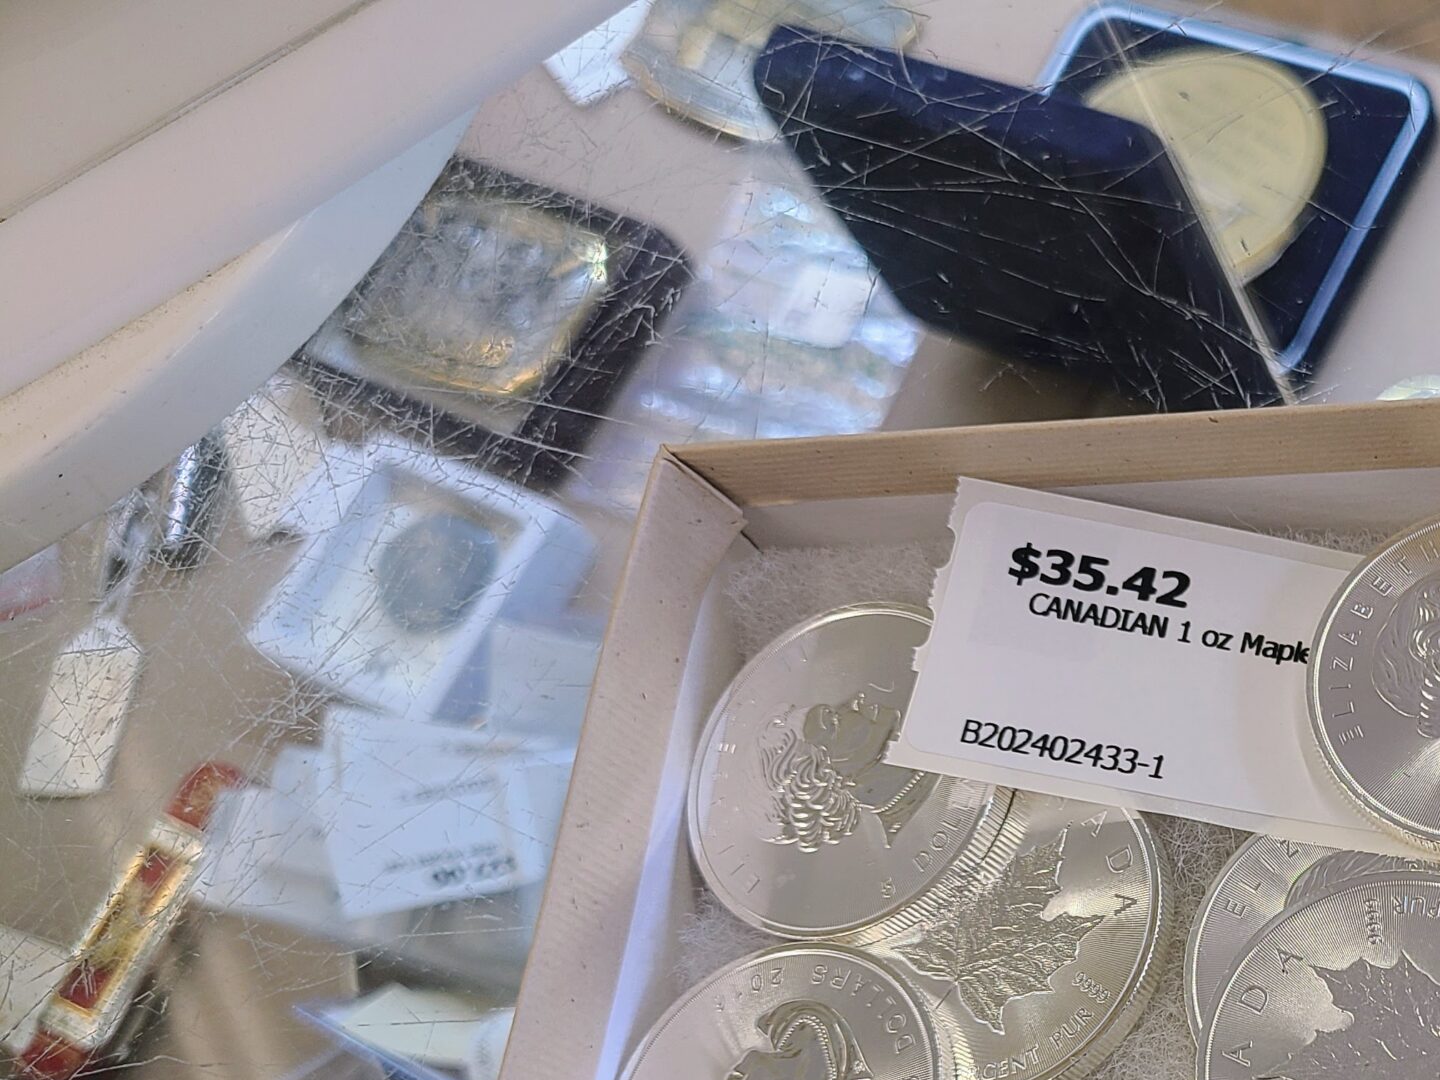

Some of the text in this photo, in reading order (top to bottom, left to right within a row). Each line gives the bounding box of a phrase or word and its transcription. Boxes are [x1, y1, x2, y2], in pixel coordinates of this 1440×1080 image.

[1008, 542, 1191, 608] $35.42
[1029, 592, 1169, 639] CANADIAN
[1176, 620, 1192, 643] 1
[1201, 629, 1234, 651] oz
[960, 718, 1165, 779] B202402433-1
[1072, 971, 1111, 1003] 9999
[1050, 1007, 1094, 1049] PUR
